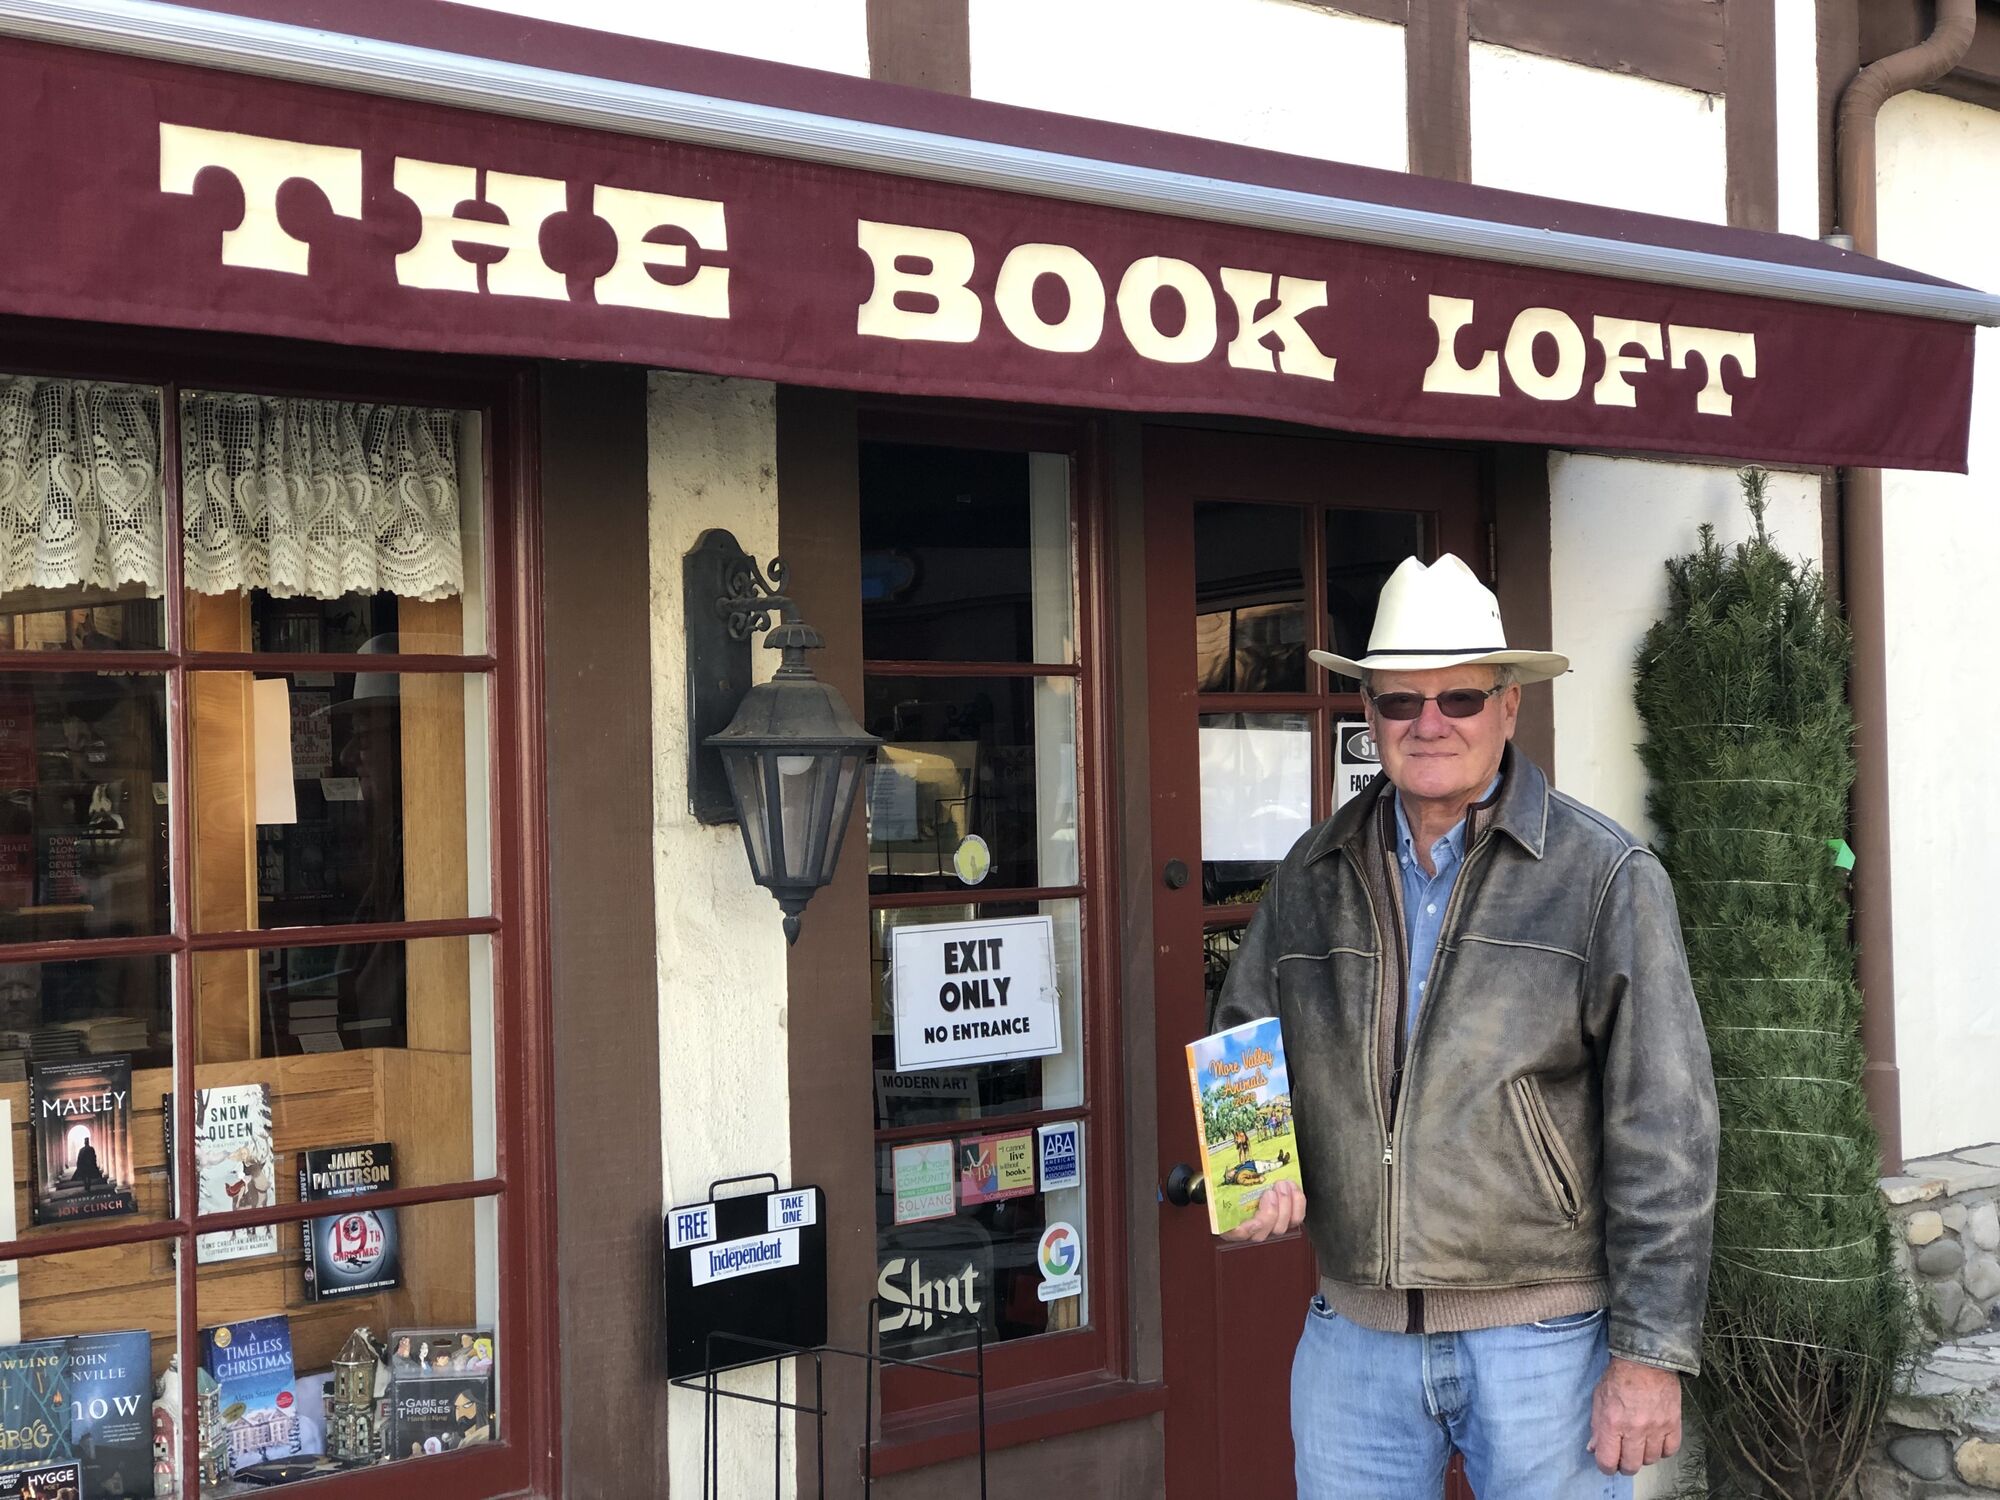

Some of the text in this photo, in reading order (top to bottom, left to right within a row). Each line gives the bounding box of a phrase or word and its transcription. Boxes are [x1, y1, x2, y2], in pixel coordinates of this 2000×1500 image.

[160, 122, 1756, 416] THE BOOK LOFT
[944, 938, 1003, 974] EXIT
[939, 977, 1011, 1012] ONLY
[924, 1017, 1030, 1044] NO ENTRANCE
[1208, 1047, 1274, 1079] More Valley
[882, 1075, 969, 1090] MODERN ART
[1222, 1068, 1269, 1098] Animals
[42, 1091, 126, 1118] MARLEY
[221, 1095, 237, 1104] THE
[211, 1104, 250, 1123] SNOW
[208, 1122, 253, 1142] QUEEN
[1046, 1134, 1075, 1156] ABA
[328, 1150, 374, 1170] JAMES
[1009, 1152, 1025, 1161] live
[300, 1171, 308, 1203] JAMES
[313, 1165, 390, 1190] PATTERSON
[333, 1187, 355, 1195] MAXINE
[58, 1200, 123, 1217] JON CLINCH
[780, 1196, 804, 1211] TAKE
[898, 1194, 952, 1213] SOLVANG
[677, 1211, 708, 1242] FREE
[782, 1210, 802, 1224] ONE
[330, 1216, 381, 1256] 19 TH
[333, 1246, 379, 1263] CHRISTMAS
[708, 1238, 782, 1277] Independent
[878, 1258, 981, 1333] Shut
[249, 1332, 256, 1341] A
[224, 1338, 283, 1361] TIMELESS
[0, 1356, 59, 1370] WLING
[70, 1353, 107, 1367] JOHN
[217, 1352, 292, 1377] CHRISTMAS
[72, 1368, 126, 1382] NVILLE
[71, 1395, 141, 1421] now
[397, 1406, 450, 1419] THRONES
[406, 1398, 437, 1408] GAME
[28, 1469, 74, 1486] HYGGE
